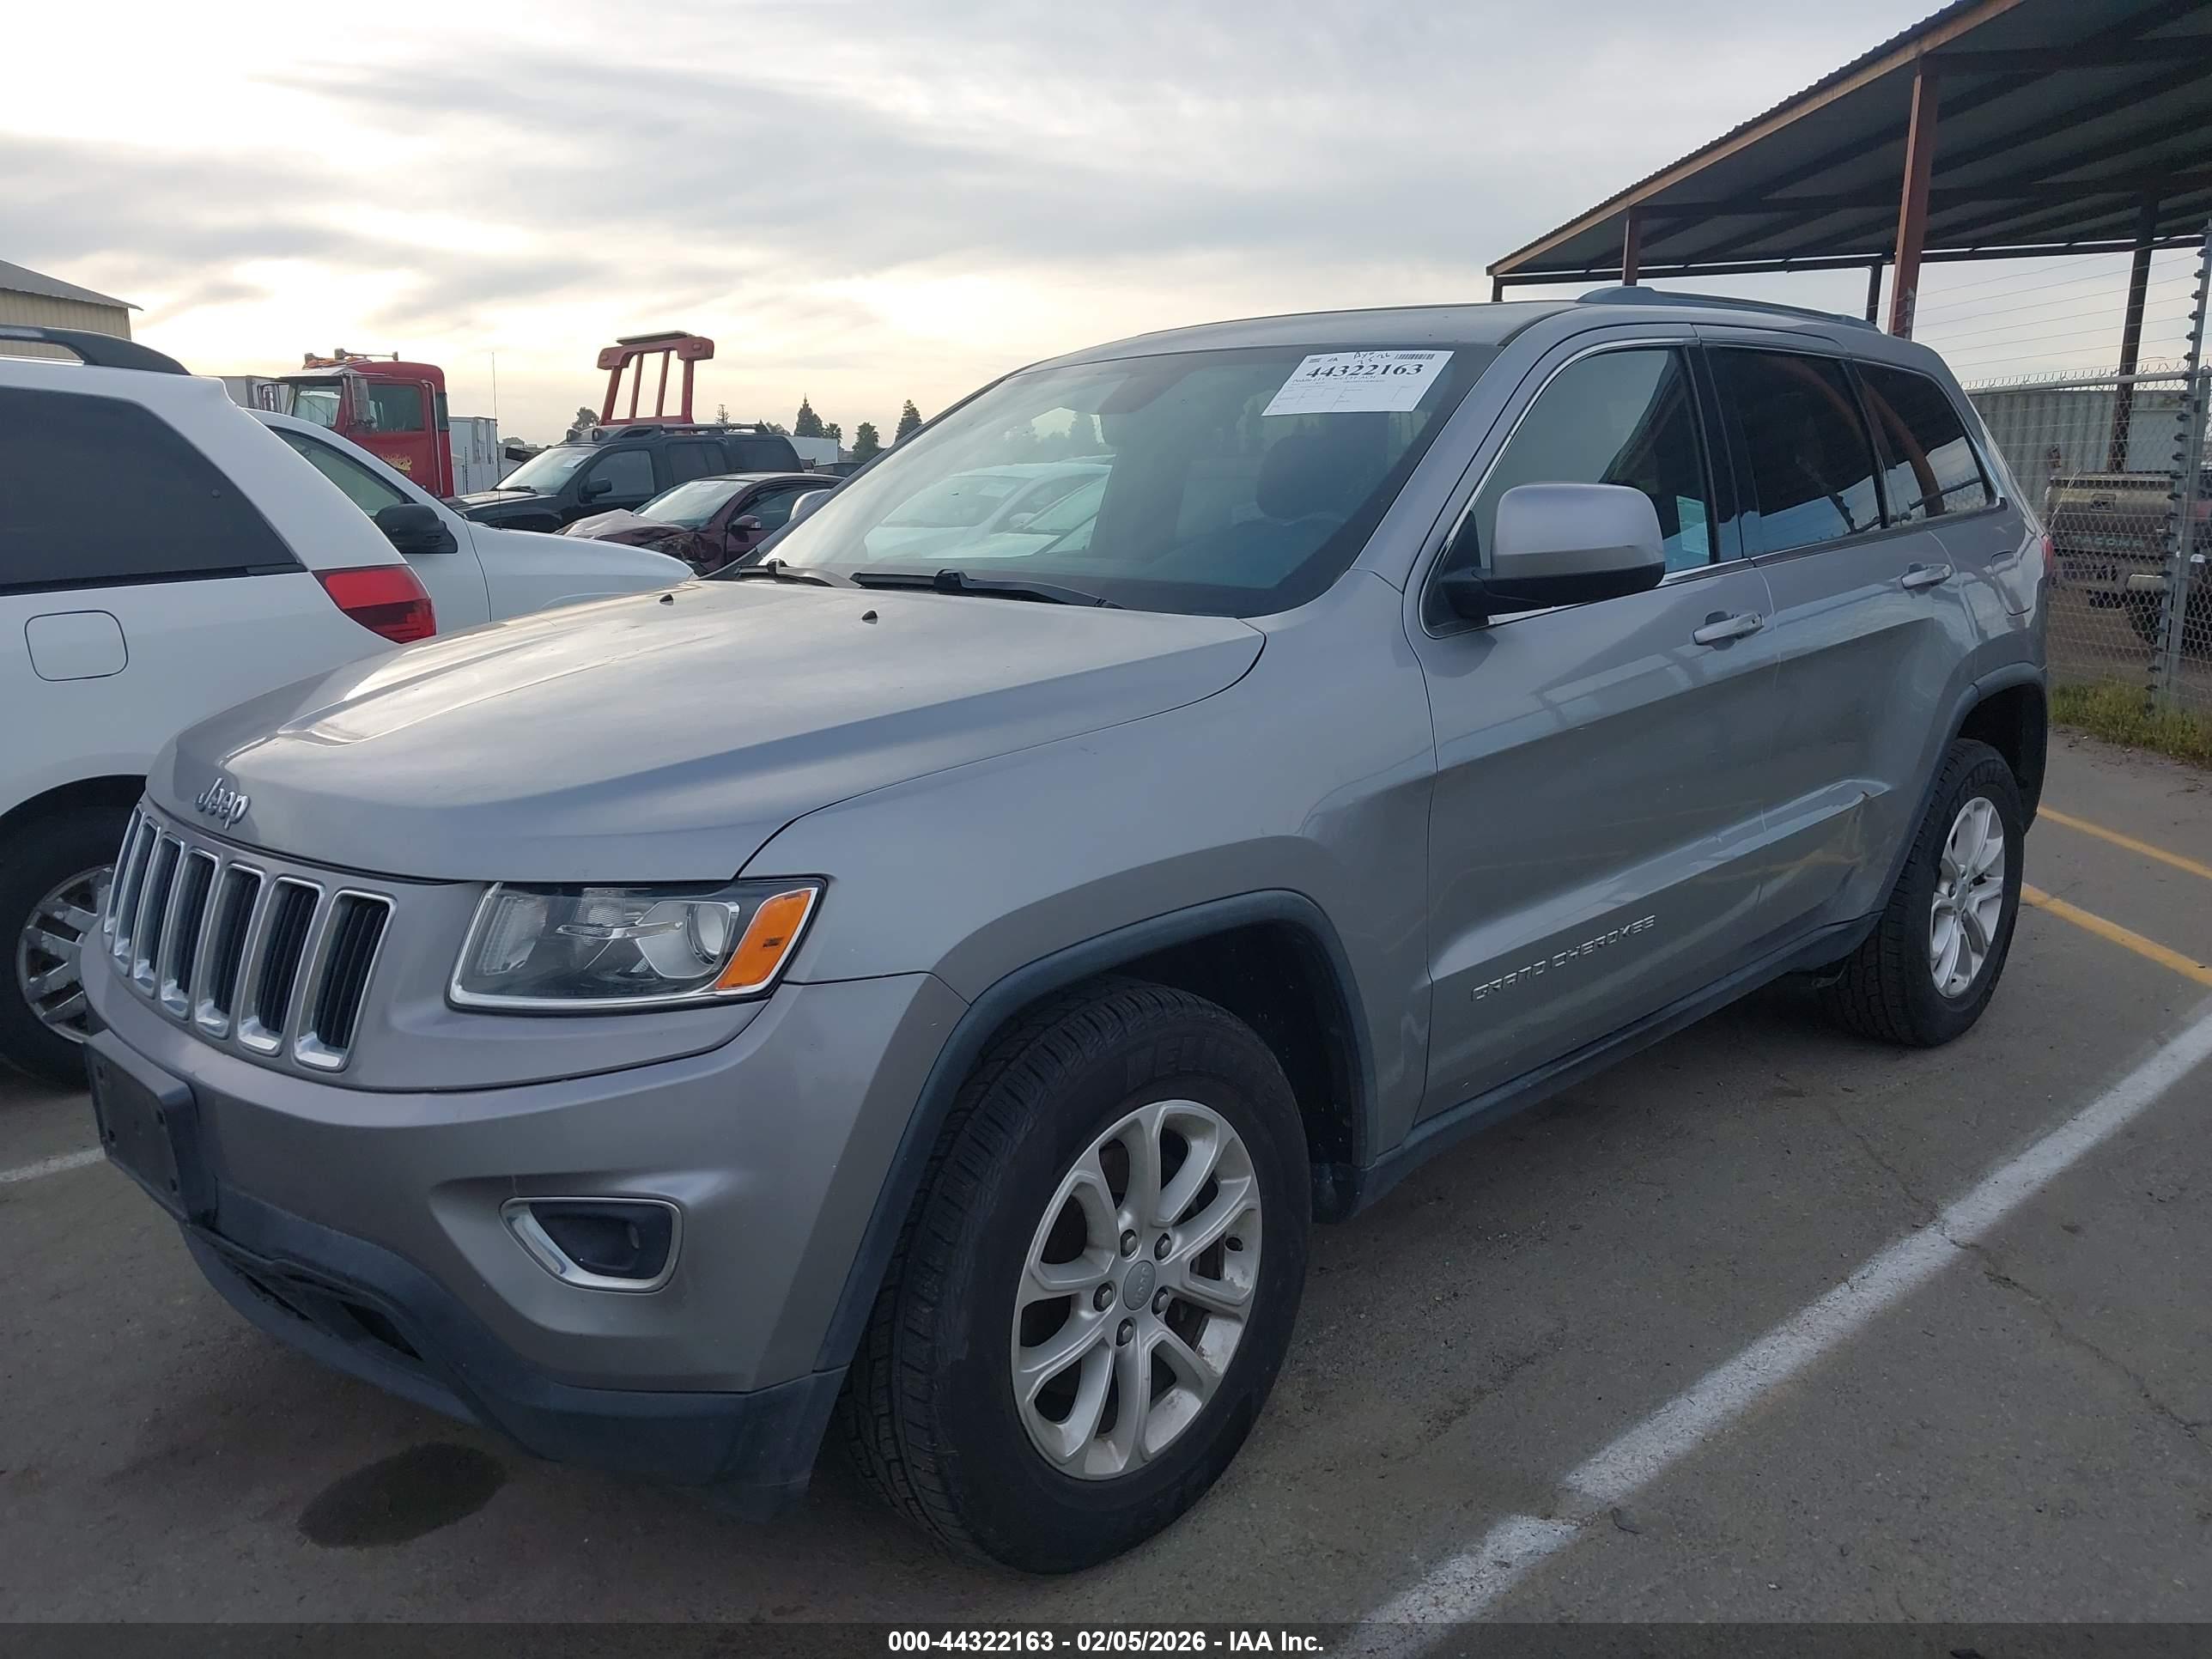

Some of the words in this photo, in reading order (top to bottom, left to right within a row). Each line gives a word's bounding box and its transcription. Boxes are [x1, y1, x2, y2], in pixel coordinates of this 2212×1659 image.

[1306, 363, 1424, 377] 44322163
[2073, 535, 2144, 548] TACOMA
[196, 777, 249, 830] Jeep
[1471, 960, 1546, 1001] GRAND
[1551, 915, 1656, 969] CHEROKEE
